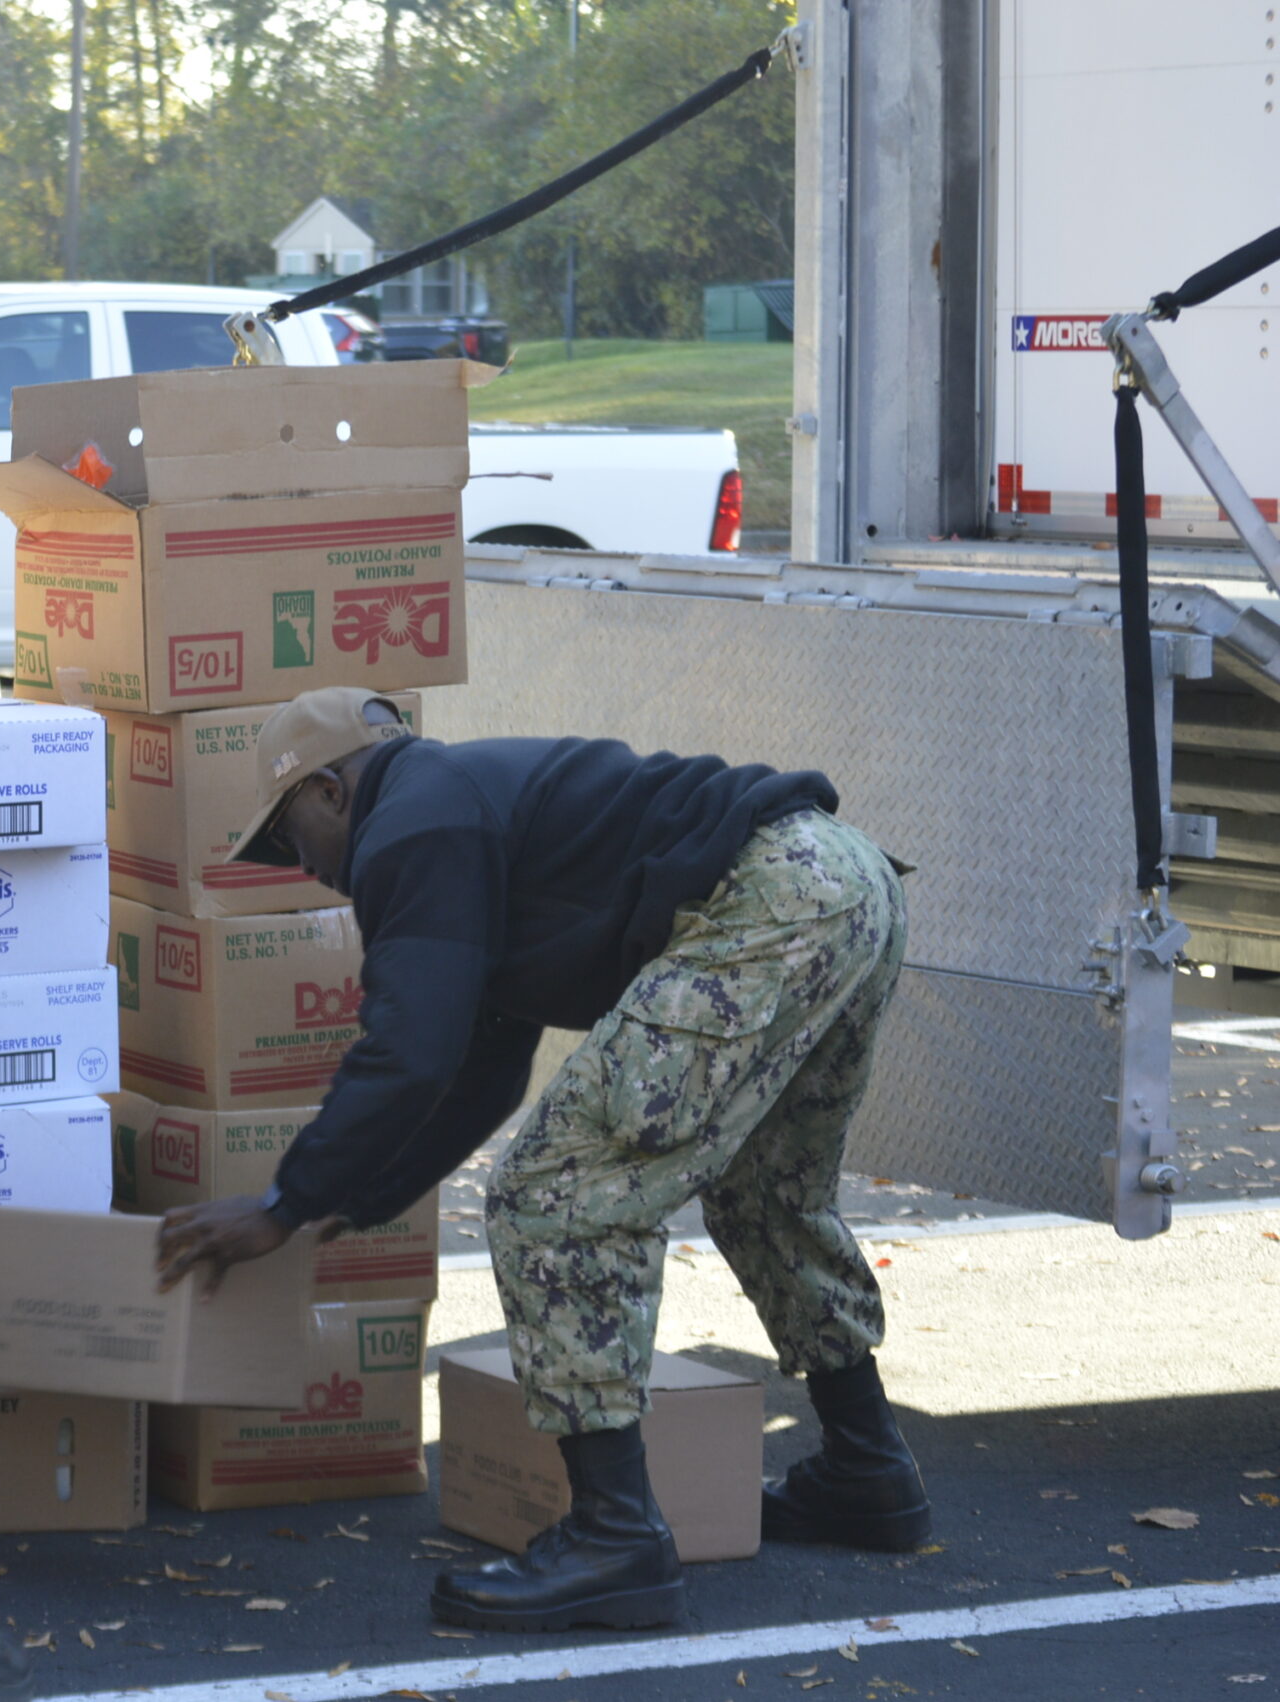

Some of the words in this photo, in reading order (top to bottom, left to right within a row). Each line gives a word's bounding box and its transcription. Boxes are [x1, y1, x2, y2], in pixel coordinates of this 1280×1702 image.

[1034, 321, 1104, 346] MORG
[327, 548, 392, 565] POTATOES
[355, 564, 415, 580] PREMIUM
[85, 582, 118, 593] PREMIUM
[44, 597, 94, 640] Dole
[332, 596, 450, 665] Dole
[18, 644, 46, 675] 10/5
[177, 648, 235, 681] 10/5
[128, 688, 142, 700] NET
[31, 732, 61, 744] SHELF
[63, 731, 94, 742] READY
[195, 727, 222, 741] NET
[225, 725, 248, 739] WT.
[33, 743, 90, 755] PACKAGING
[135, 737, 168, 773] 10/5
[196, 742, 223, 755] U.S.
[225, 739, 249, 753] NO.
[15, 783, 47, 796] ROLLS
[226, 933, 252, 947] NET
[255, 932, 277, 945] WT.
[280, 930, 295, 942] 50
[160, 941, 195, 978] 10/5
[226, 948, 252, 961] U.S.
[255, 945, 278, 959] NO.
[283, 945, 288, 956] 1
[46, 985, 73, 996] SHELF
[75, 981, 105, 993] READY
[48, 993, 101, 1006] PACKAGING
[31, 1035, 62, 1047] ROLLS
[255, 1032, 310, 1048] PREMIUM
[81, 1057, 104, 1069] Dept.
[226, 1126, 252, 1139] NET
[254, 1125, 276, 1137] WT.
[280, 1124, 294, 1136] 50
[156, 1132, 193, 1170] 10/5
[226, 1141, 251, 1153] U.S.
[254, 1140, 277, 1151] NO.
[281, 1139, 286, 1150] 1
[366, 1328, 416, 1357] 10/5
[306, 1371, 364, 1416] ole
[239, 1425, 295, 1439] PREMIUM
[345, 1420, 401, 1434] POTATOES
